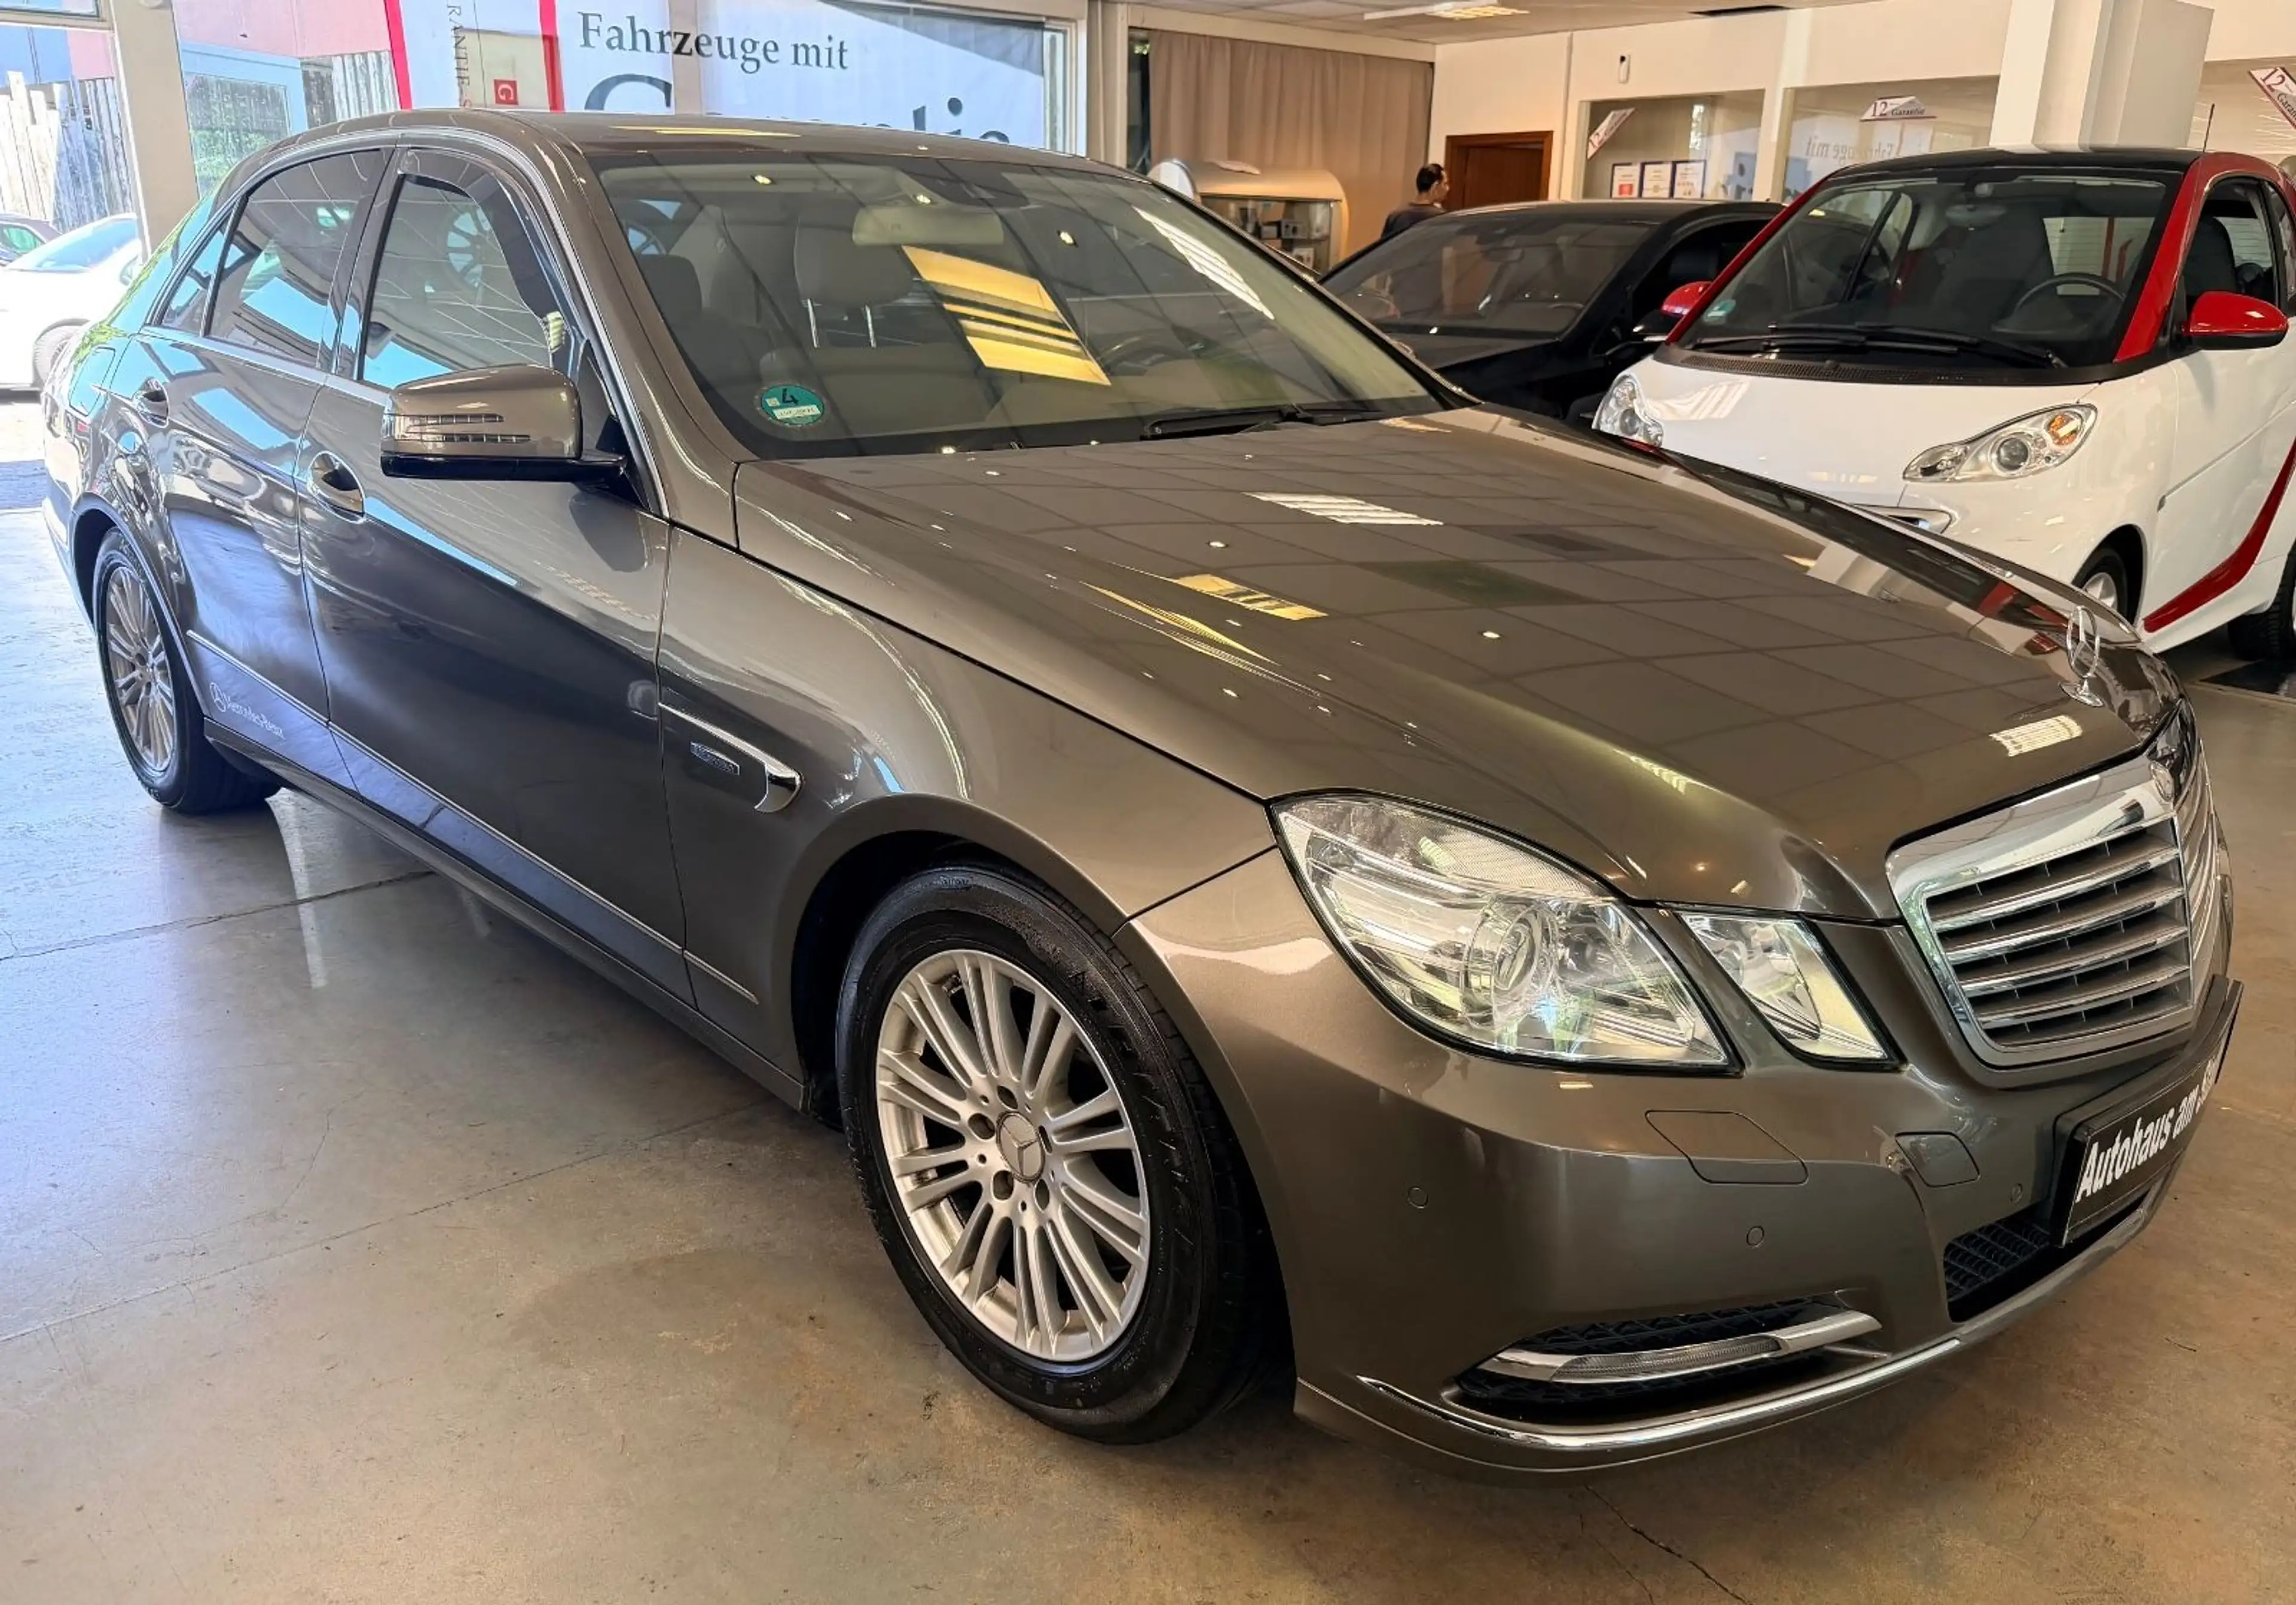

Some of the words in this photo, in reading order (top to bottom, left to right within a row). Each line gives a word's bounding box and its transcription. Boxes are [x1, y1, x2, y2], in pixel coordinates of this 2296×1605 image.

[577, 11, 779, 74] Fahrzeuge
[790, 35, 848, 70] mit
[2260, 68, 2286, 93] 12
[1871, 101, 1888, 117] 12
[1891, 108, 1925, 116] Garantie
[782, 388, 799, 405] 4
[2075, 1106, 2175, 1203] Autohaus
